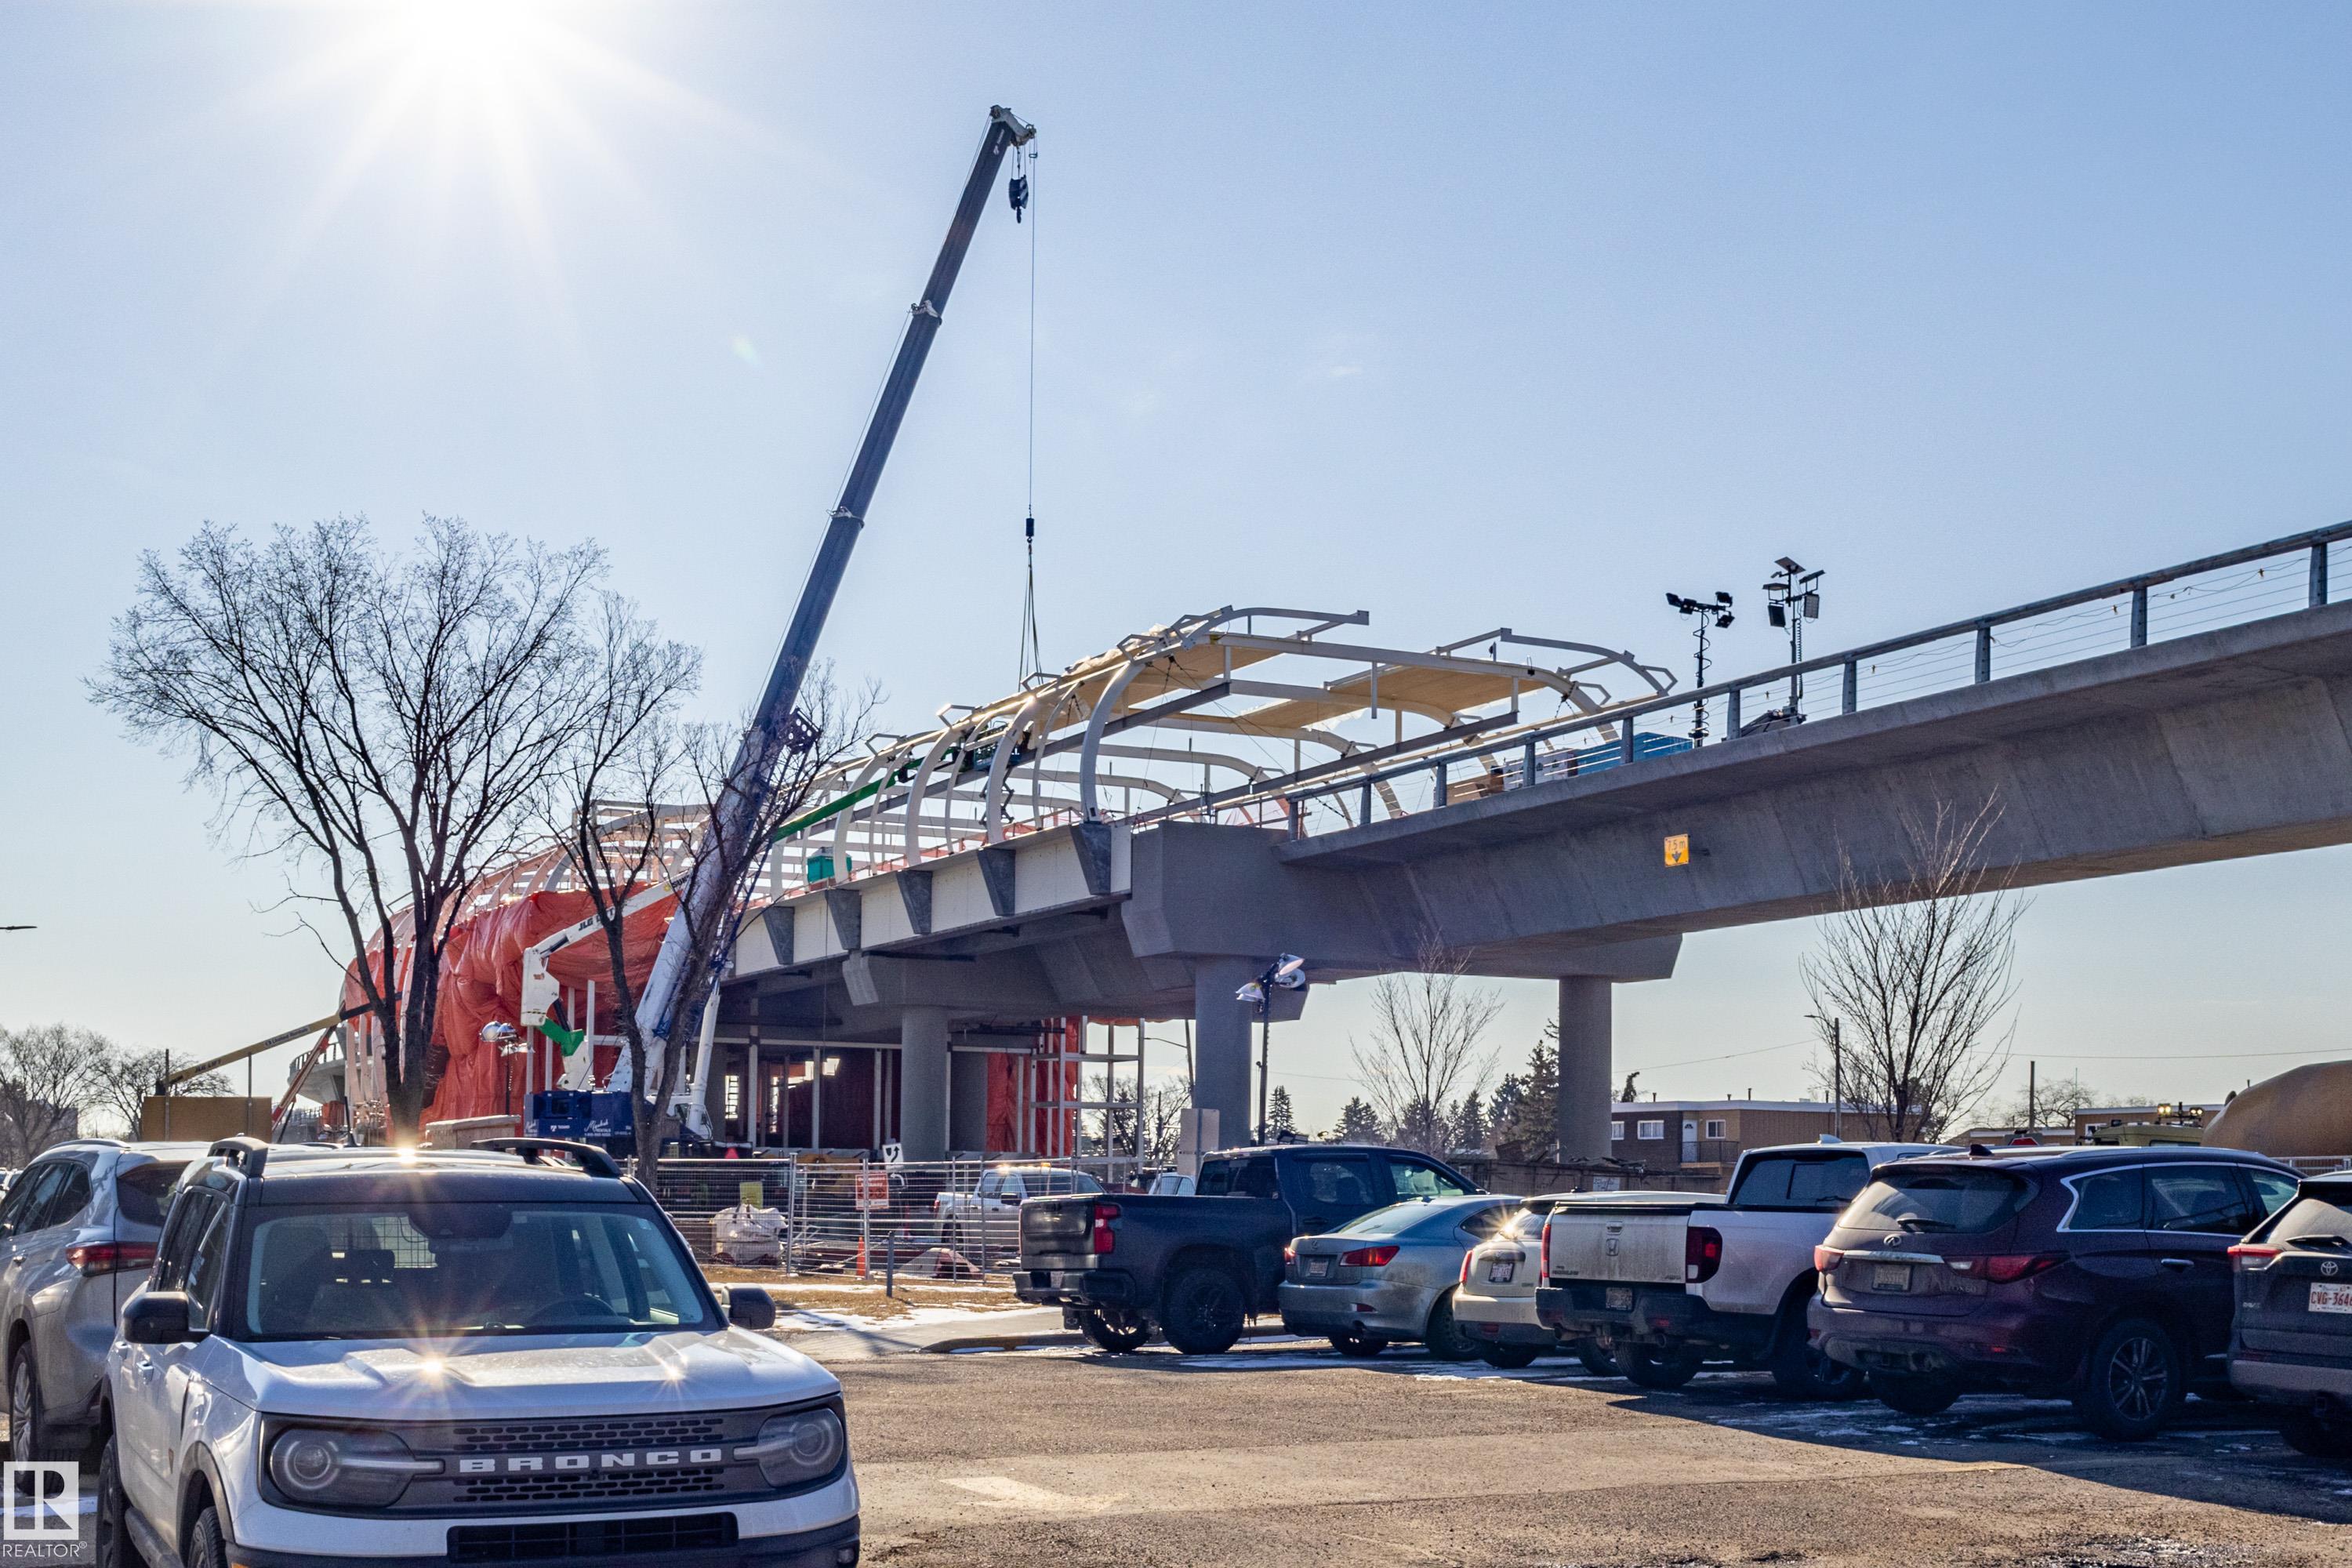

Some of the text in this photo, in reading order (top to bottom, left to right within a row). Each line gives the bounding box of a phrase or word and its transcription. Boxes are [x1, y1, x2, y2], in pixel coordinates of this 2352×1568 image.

[1667, 839, 1686, 851] 7.5 m
[459, 1449, 721, 1473] BRONCO
